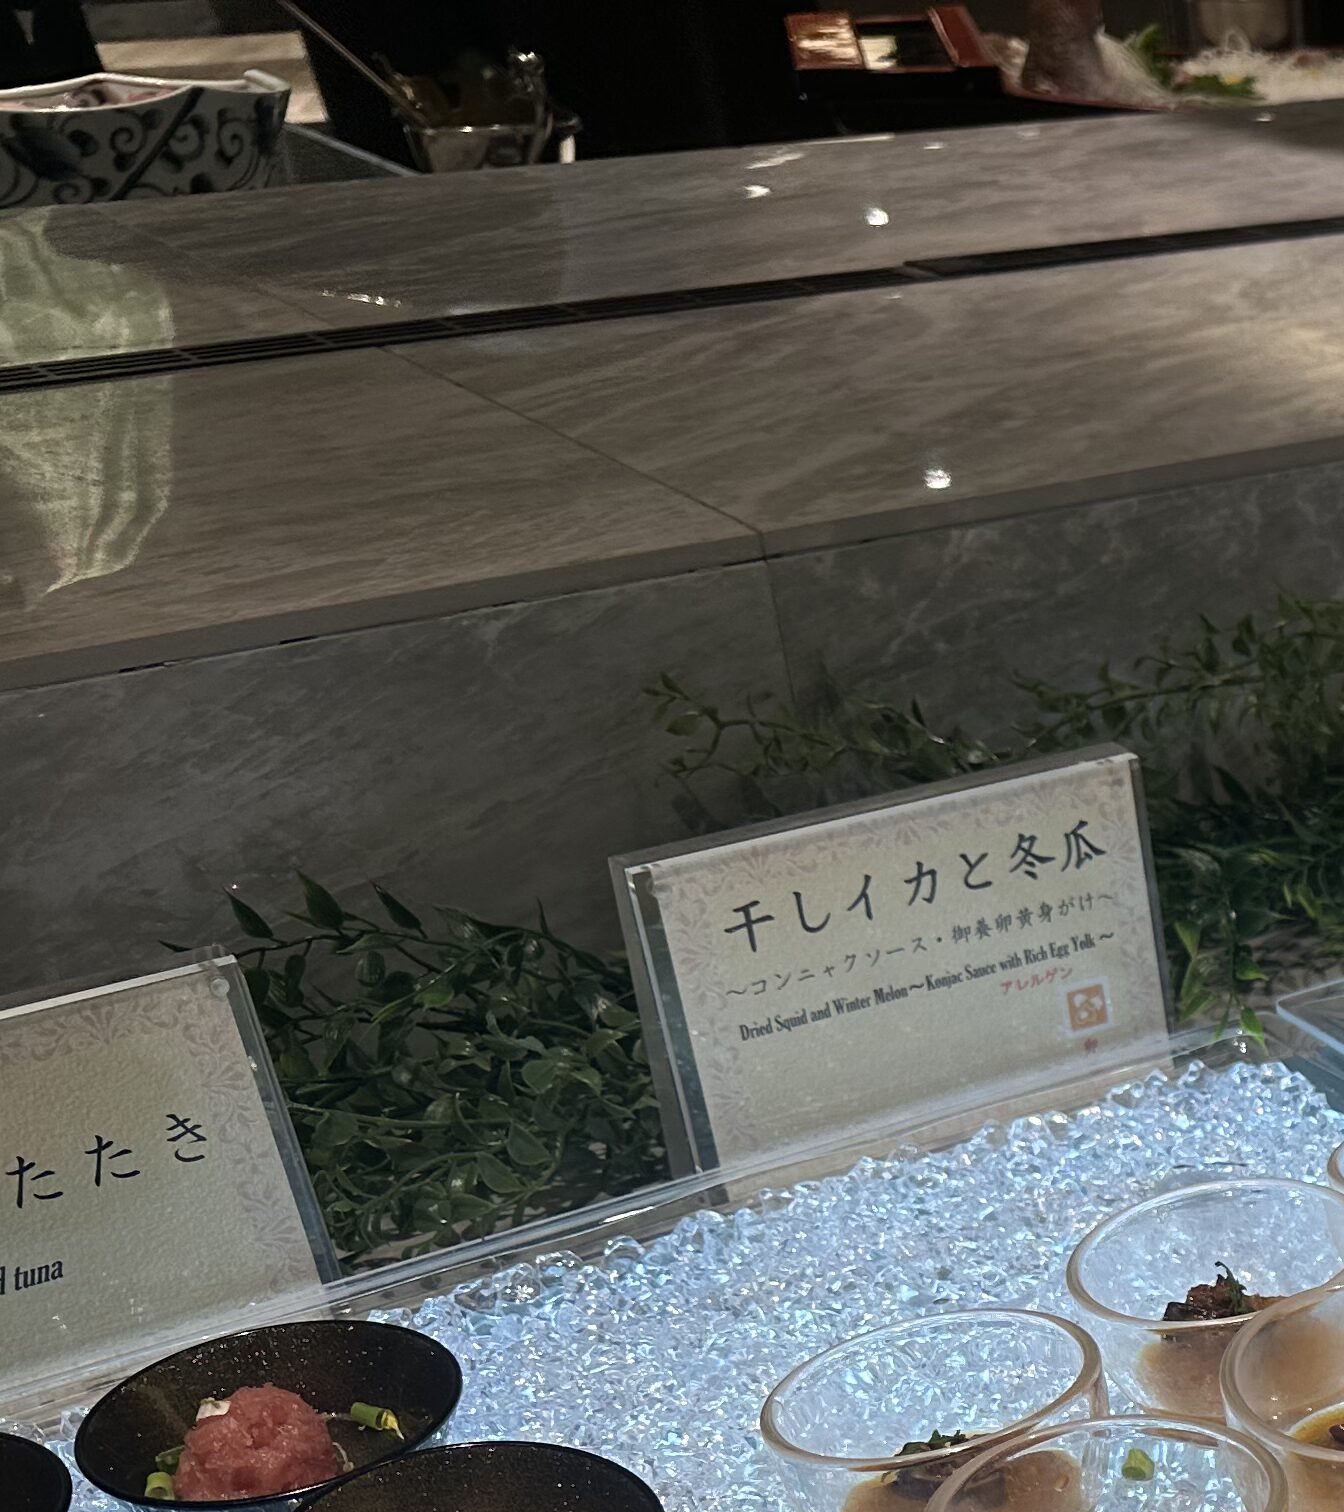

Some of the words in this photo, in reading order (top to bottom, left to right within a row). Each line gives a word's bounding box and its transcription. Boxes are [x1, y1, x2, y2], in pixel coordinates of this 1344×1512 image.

[724, 820, 1106, 952] 干しイカと冬瓜
[739, 1017, 773, 1041] Dried
[774, 1008, 808, 1032] Squid
[810, 1002, 832, 1022] and
[833, 996, 871, 1015] Winter
[964, 963, 997, 981] Sauce
[999, 952, 1023, 971] with
[1024, 946, 1049, 966] Rich
[1049, 941, 1070, 960] Egg
[1070, 933, 1096, 953] Yolk
[1000, 966, 1073, 995] アレルゲン
[5, 1113, 207, 1209] たたき
[14, 1260, 64, 1291] tuna
